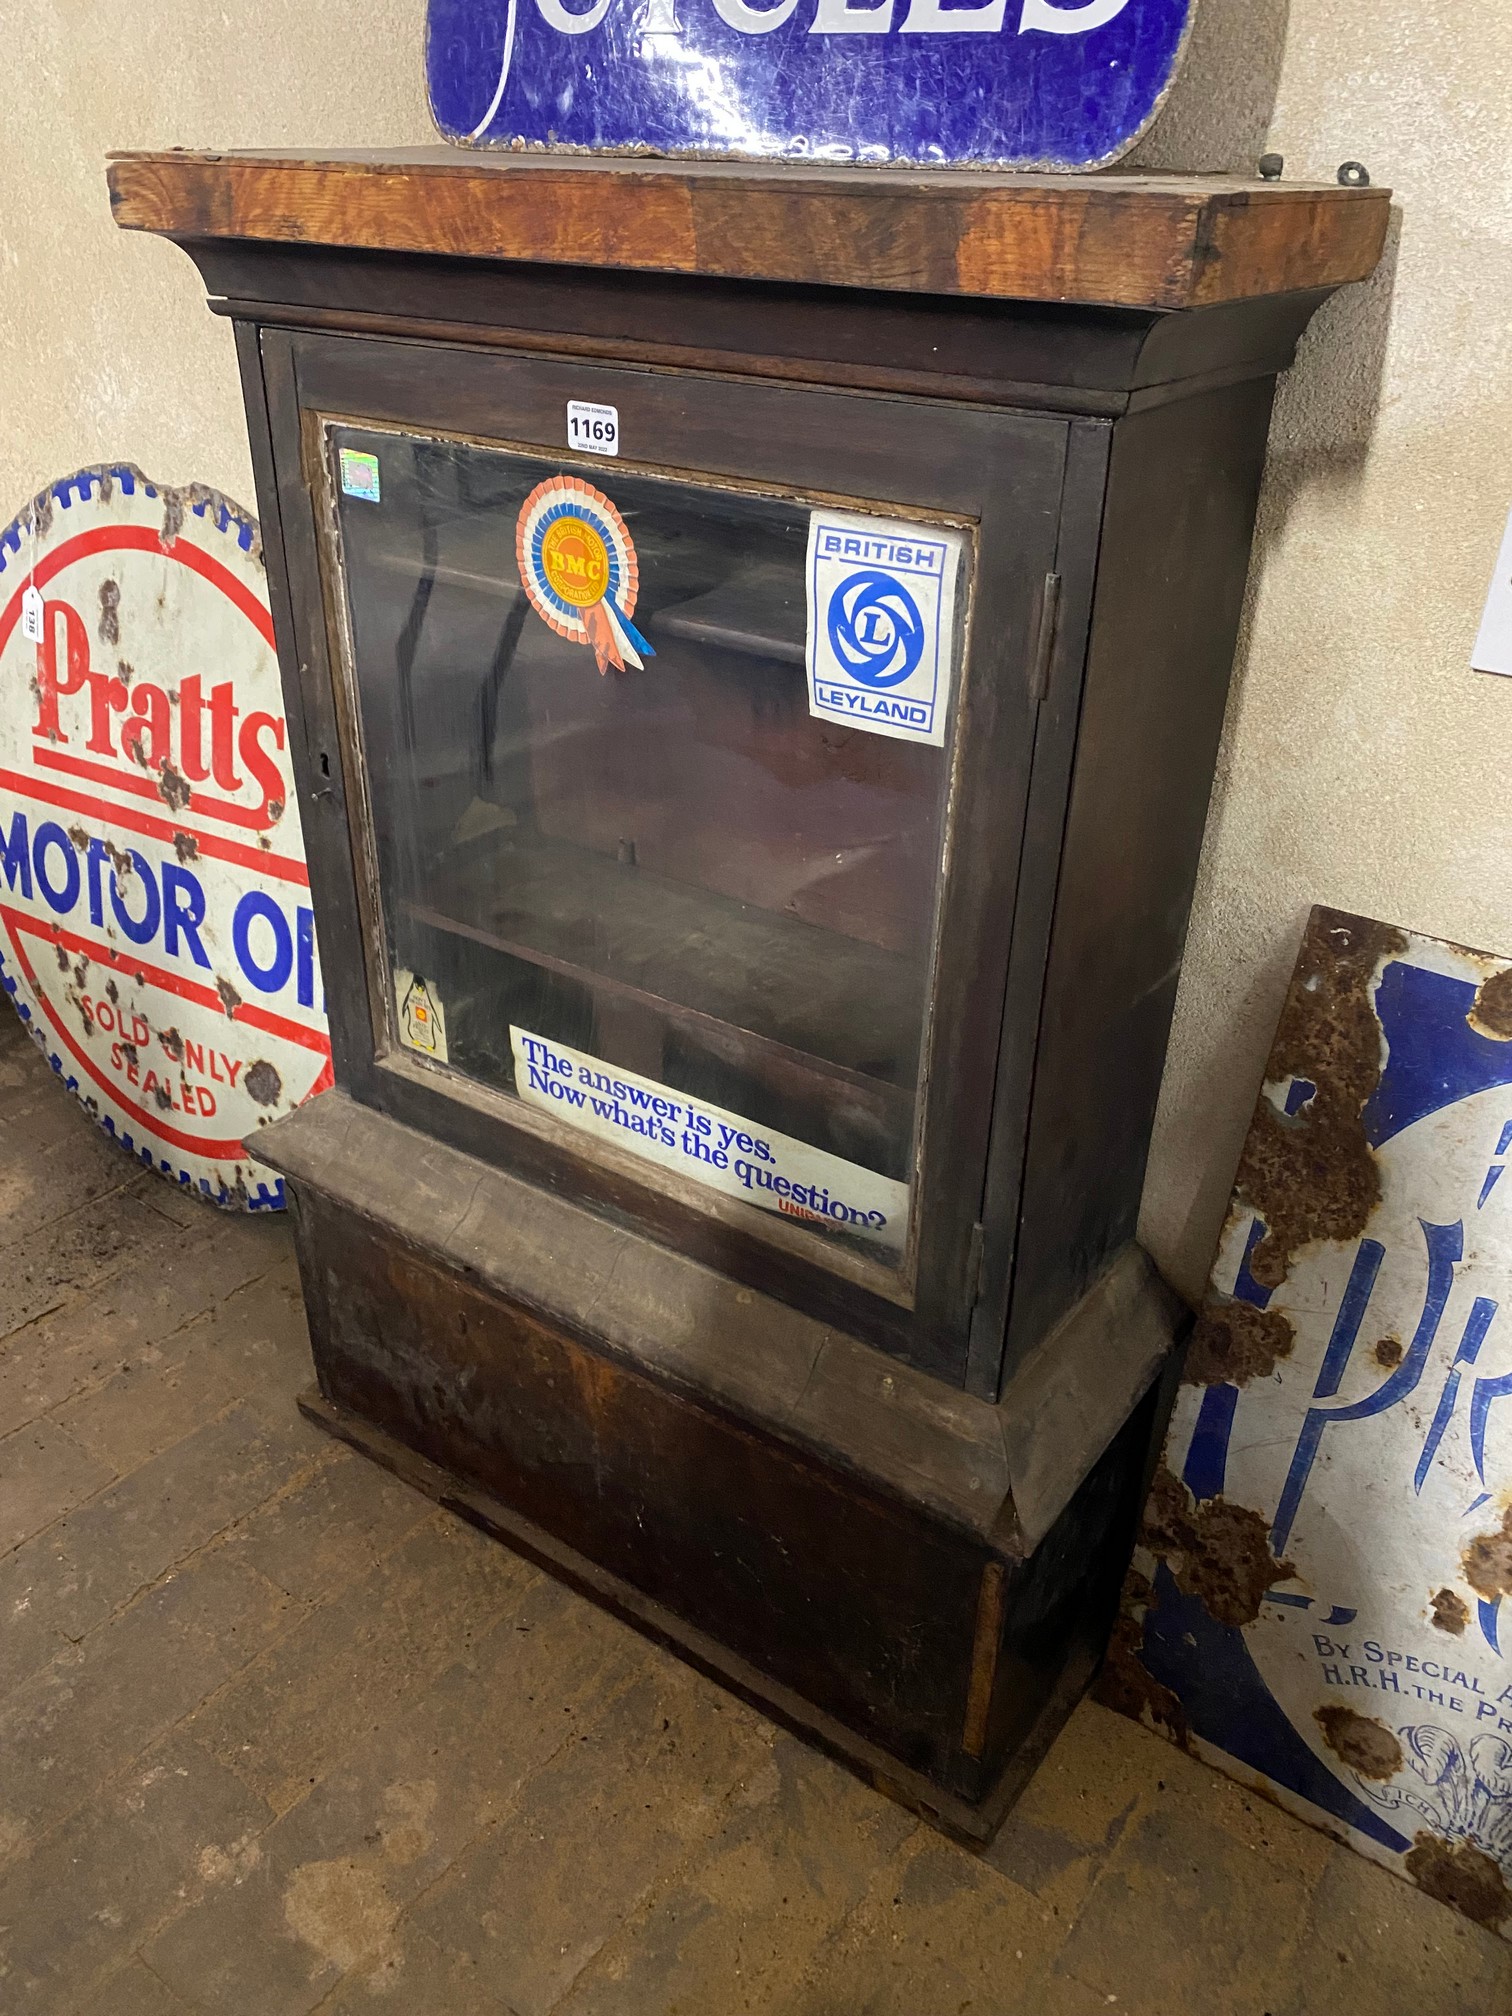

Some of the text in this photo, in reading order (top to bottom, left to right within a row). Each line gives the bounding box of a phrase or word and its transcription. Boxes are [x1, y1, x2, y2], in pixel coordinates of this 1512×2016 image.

[570, 417, 615, 442] 1169
[549, 550, 601, 580] BMC
[824, 535, 935, 568] BRITISH
[859, 612, 891, 646] L
[31, 600, 286, 831] Pratts
[818, 687, 927, 724] LEYLAND
[0, 811, 328, 1016] MOTOR OI
[81, 994, 150, 1047] SOLD
[111, 1042, 217, 1117] SEALED
[522, 1036, 777, 1164] The answer is yes.
[527, 1064, 887, 1232] Now what's the question?
[1363, 1641, 1485, 1696] SPECIAL
